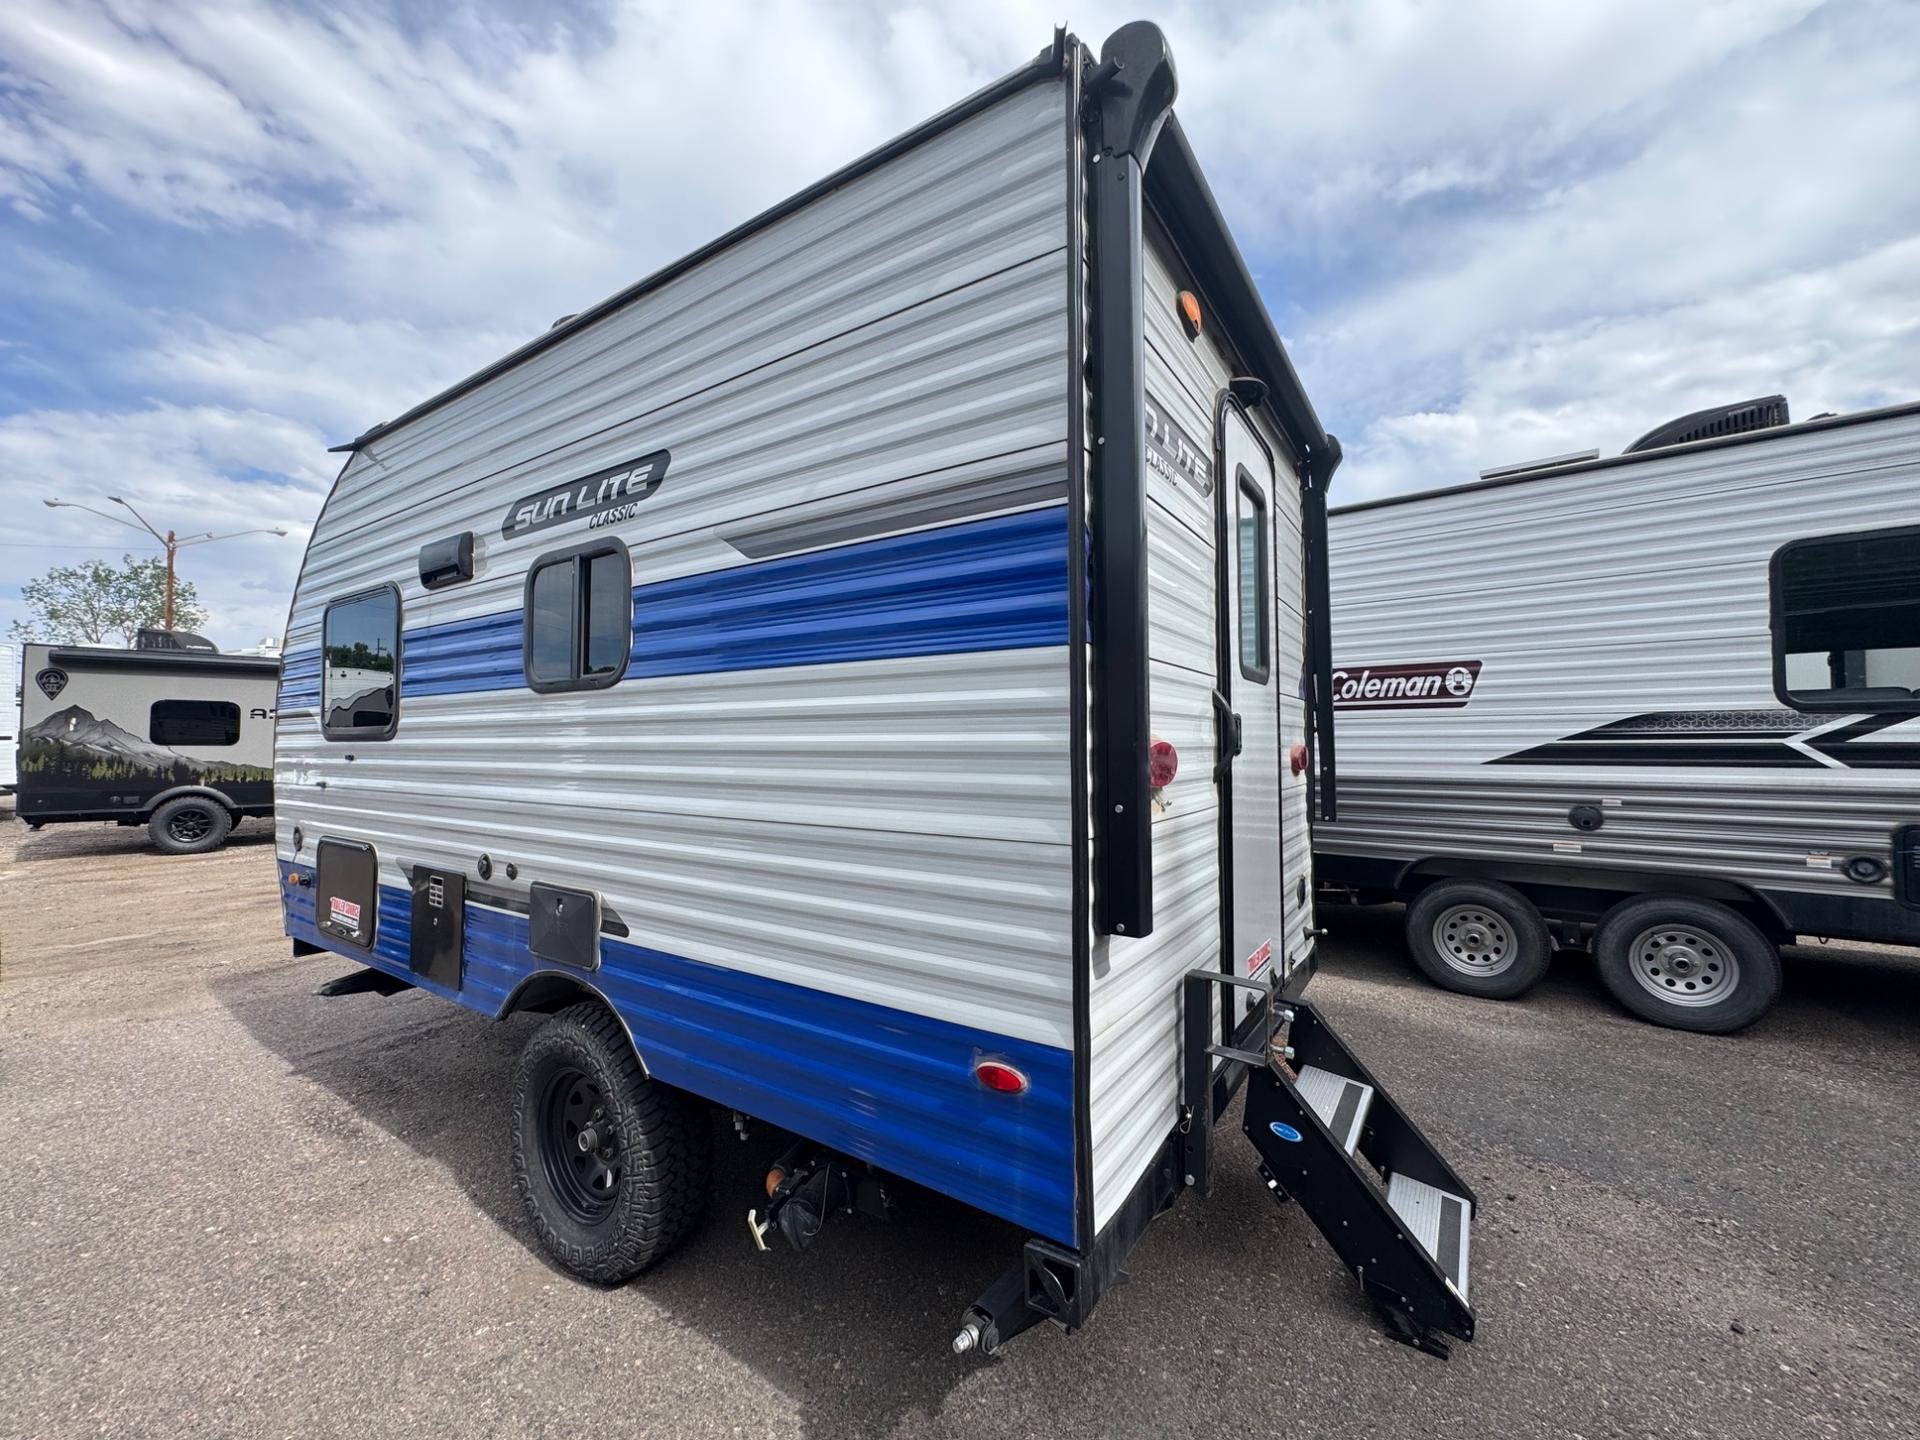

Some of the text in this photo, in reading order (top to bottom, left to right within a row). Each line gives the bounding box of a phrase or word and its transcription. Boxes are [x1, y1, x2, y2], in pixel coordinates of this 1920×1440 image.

[1163, 423, 1206, 488] LITE
[514, 464, 653, 530] SUN LITE
[589, 503, 638, 529] CLASSIC
[1333, 670, 1442, 701] Coleman
